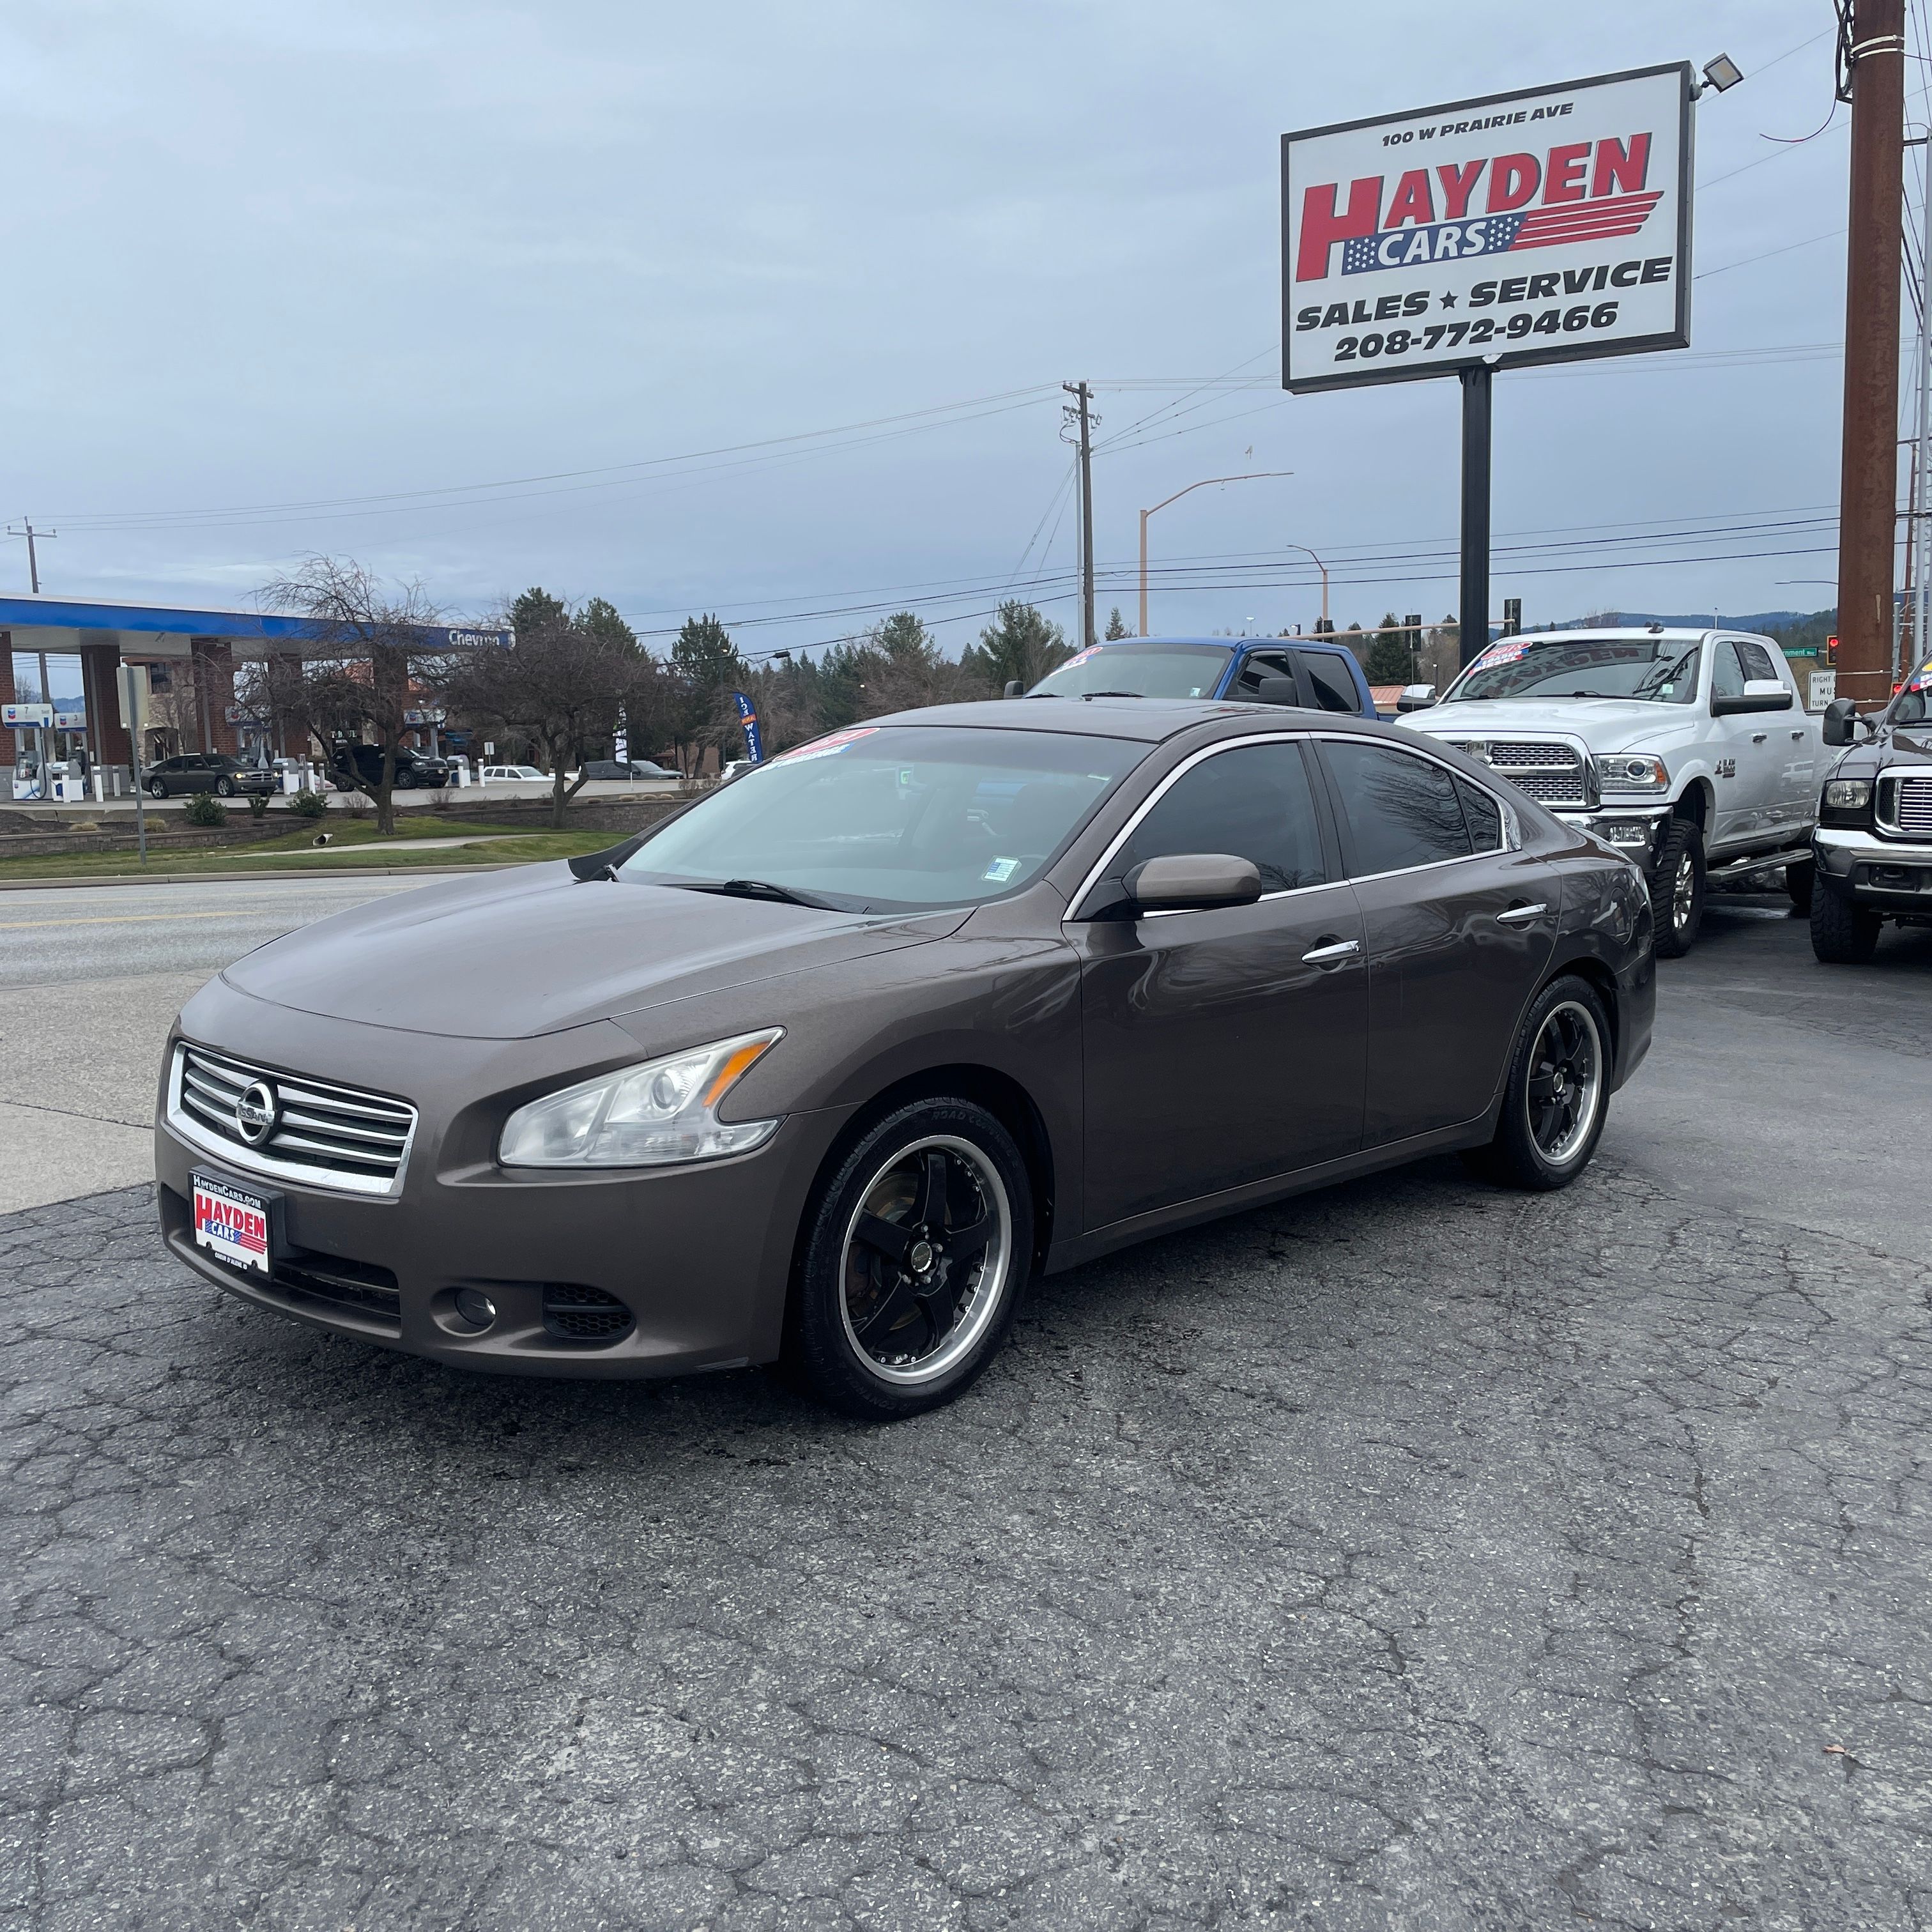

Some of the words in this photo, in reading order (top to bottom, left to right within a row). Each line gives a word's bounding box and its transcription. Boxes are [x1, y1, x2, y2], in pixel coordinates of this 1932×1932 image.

[1382, 131, 1414, 147] 100
[1419, 126, 1437, 141] W
[1439, 111, 1528, 137] PRAIRIE
[1529, 102, 1574, 121] AVE
[1296, 132, 1653, 282] HAYDEN
[1377, 220, 1488, 266] CARS
[1296, 291, 1431, 331] SALES
[1469, 256, 1673, 308] SERVICE
[1334, 302, 1620, 362] 208-772-9466
[24, 706, 29, 714] 7
[196, 1193, 265, 1239] HAYDEN
[211, 1222, 235, 1242] CARS
